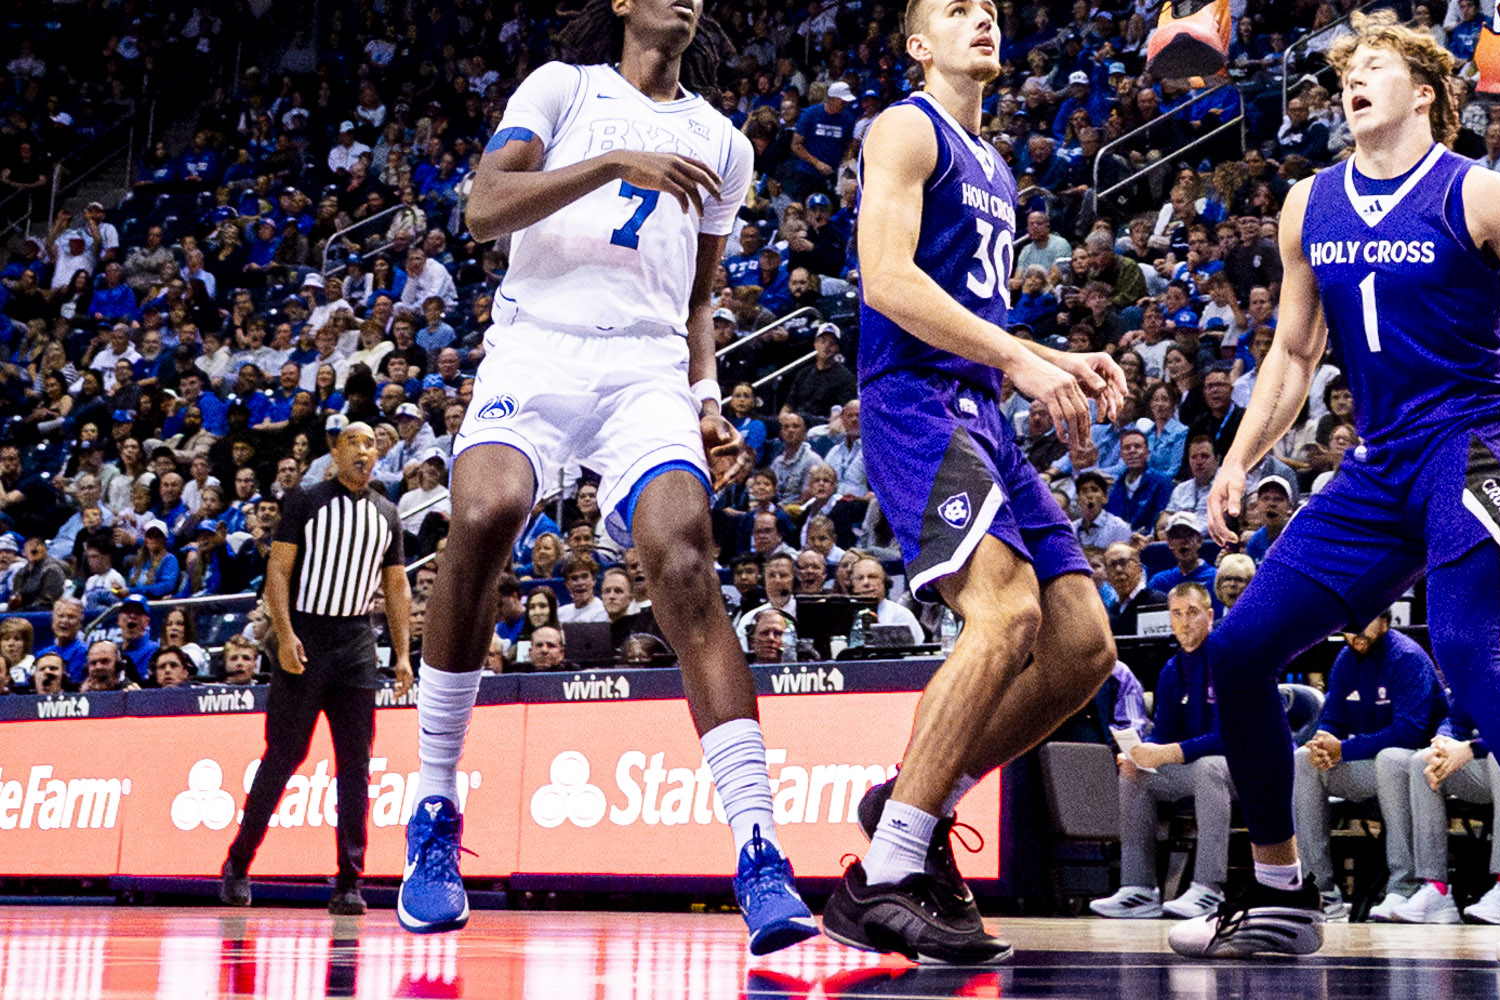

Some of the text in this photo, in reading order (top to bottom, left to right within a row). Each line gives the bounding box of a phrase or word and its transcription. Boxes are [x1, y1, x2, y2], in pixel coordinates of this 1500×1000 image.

[962, 183, 988, 214] HOLY
[610, 179, 660, 250] 7
[966, 217, 1014, 310] 30
[1311, 240, 1435, 266] HOLY CROSS
[1358, 271, 1382, 353] 1
[563, 674, 614, 700] vivint
[771, 666, 827, 694] vivint
[37, 695, 77, 718] vivint
[197, 688, 241, 712] vivint
[609, 750, 730, 826] Stat
